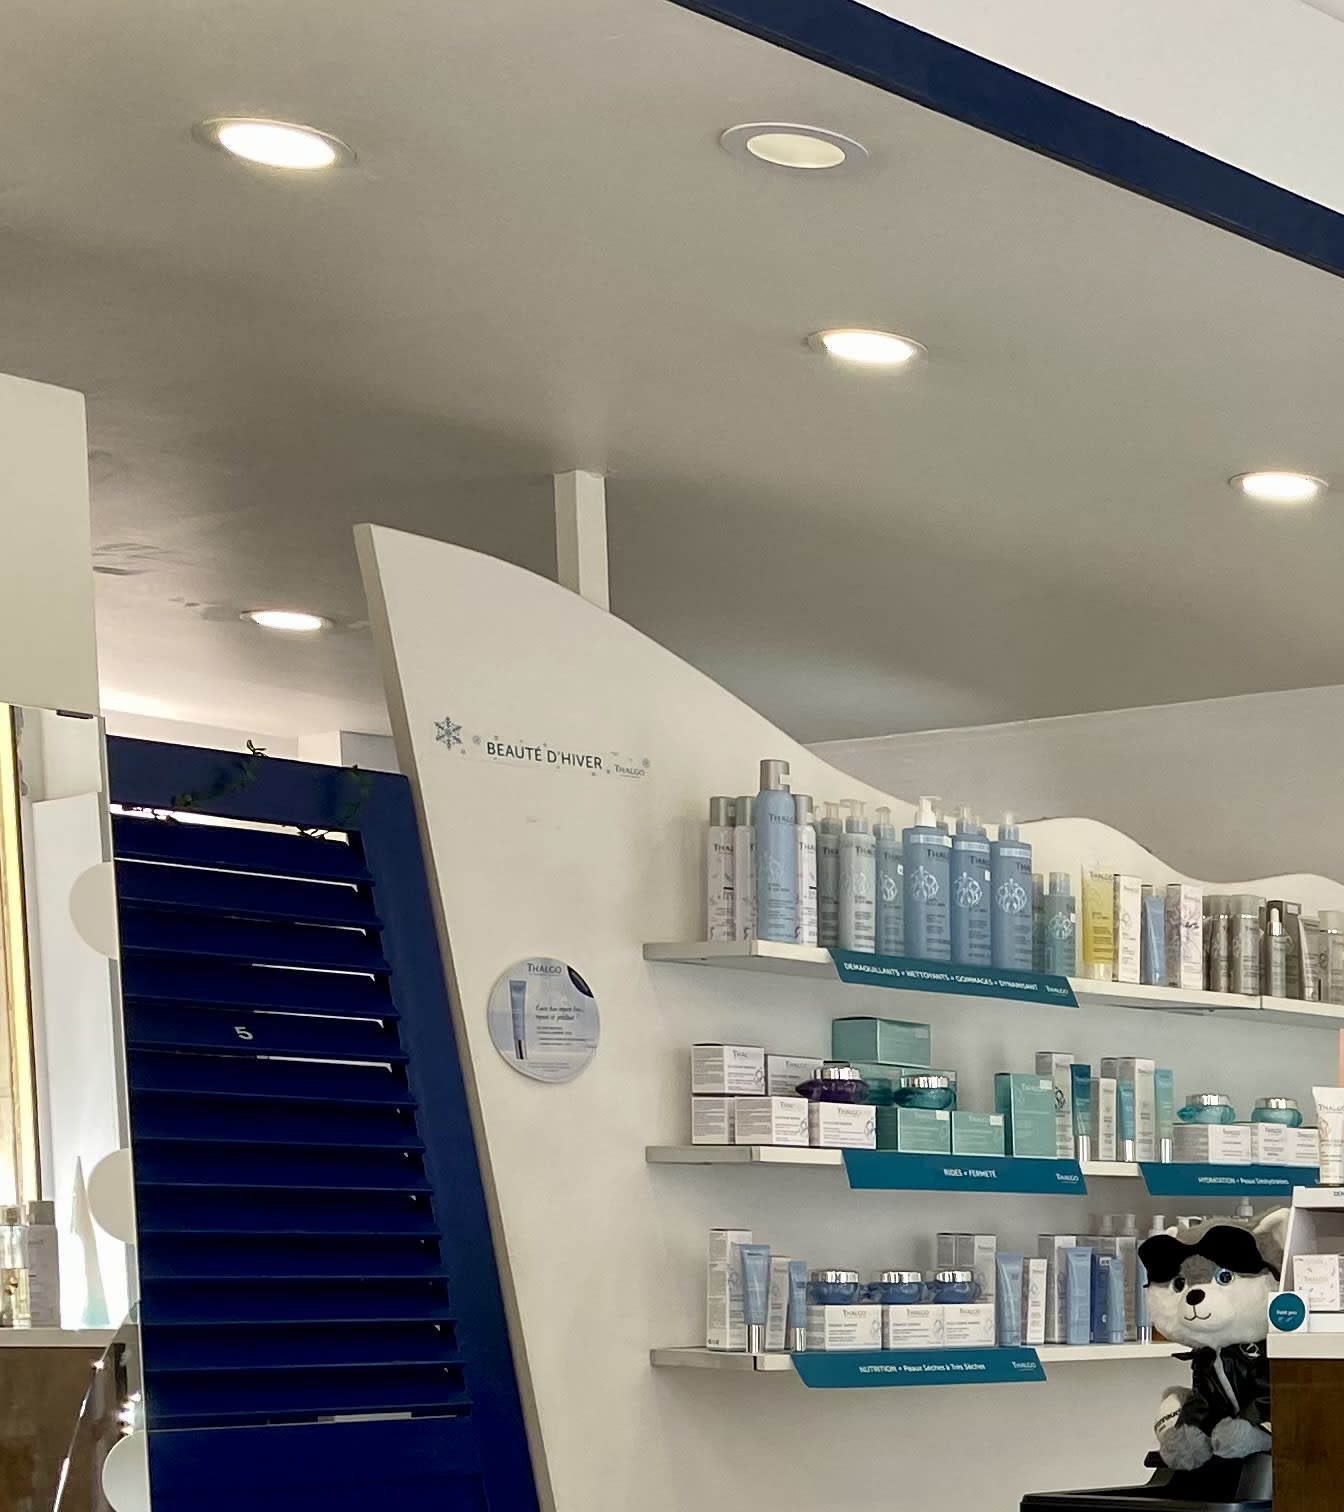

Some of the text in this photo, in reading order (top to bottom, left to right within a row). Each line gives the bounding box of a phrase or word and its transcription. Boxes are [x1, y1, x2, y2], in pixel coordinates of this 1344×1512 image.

[486, 741, 603, 770] BEAUTÉ D'HIVER
[614, 764, 645, 777] THALGO
[527, 963, 562, 974] THALGO
[234, 1026, 254, 1040] 5
